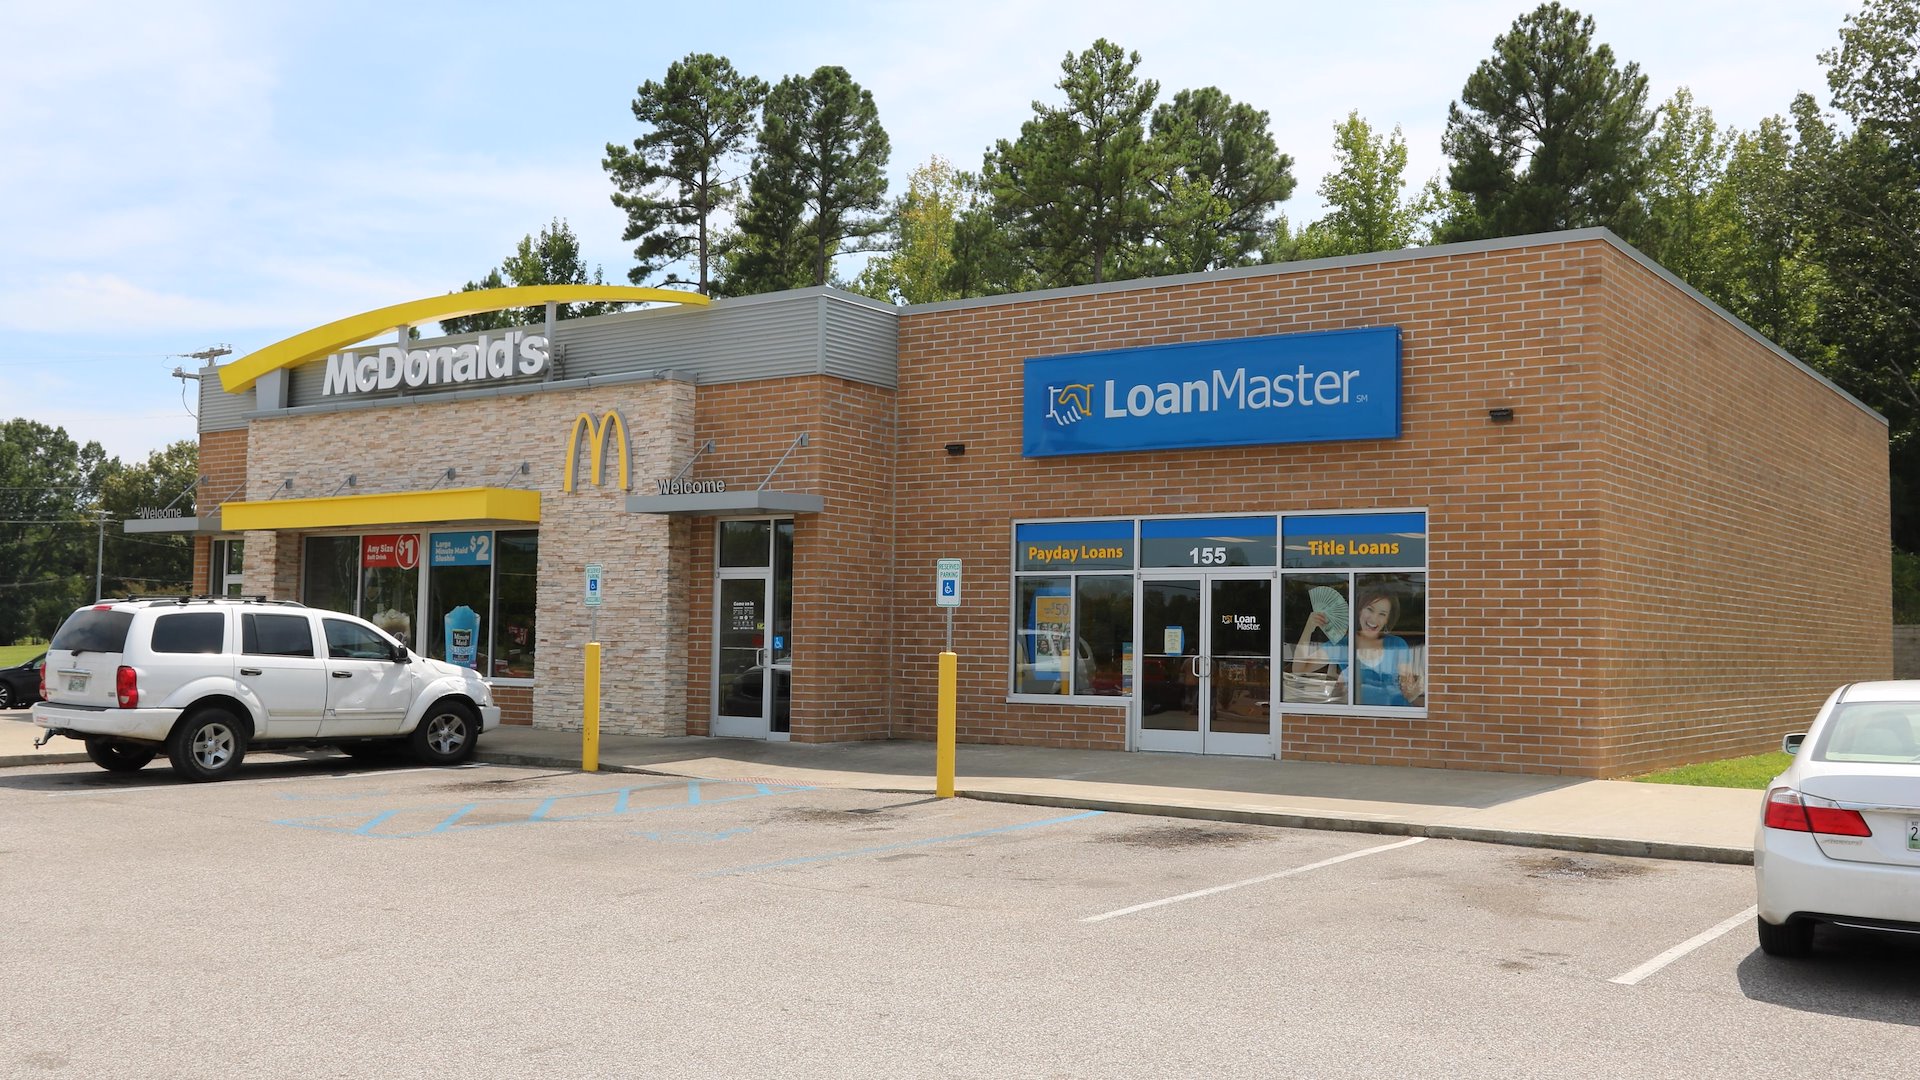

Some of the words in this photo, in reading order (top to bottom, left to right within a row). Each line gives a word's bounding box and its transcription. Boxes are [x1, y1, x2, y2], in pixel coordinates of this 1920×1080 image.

[322, 331, 547, 396] McDonald's
[1104, 364, 1360, 419] LoanMaster
[656, 478, 727, 495] Welcome
[140, 506, 182, 519] Welcome
[367, 545, 380, 555] Any
[380, 543, 394, 553] Size
[398, 539, 414, 564] $1
[470, 535, 490, 561] $2
[1028, 544, 1079, 564] Payday
[1081, 545, 1124, 559] Loans
[1189, 547, 1228, 565] 155
[1308, 540, 1346, 556] Title
[1349, 541, 1400, 555] Loans
[1234, 614, 1256, 623] Loan
